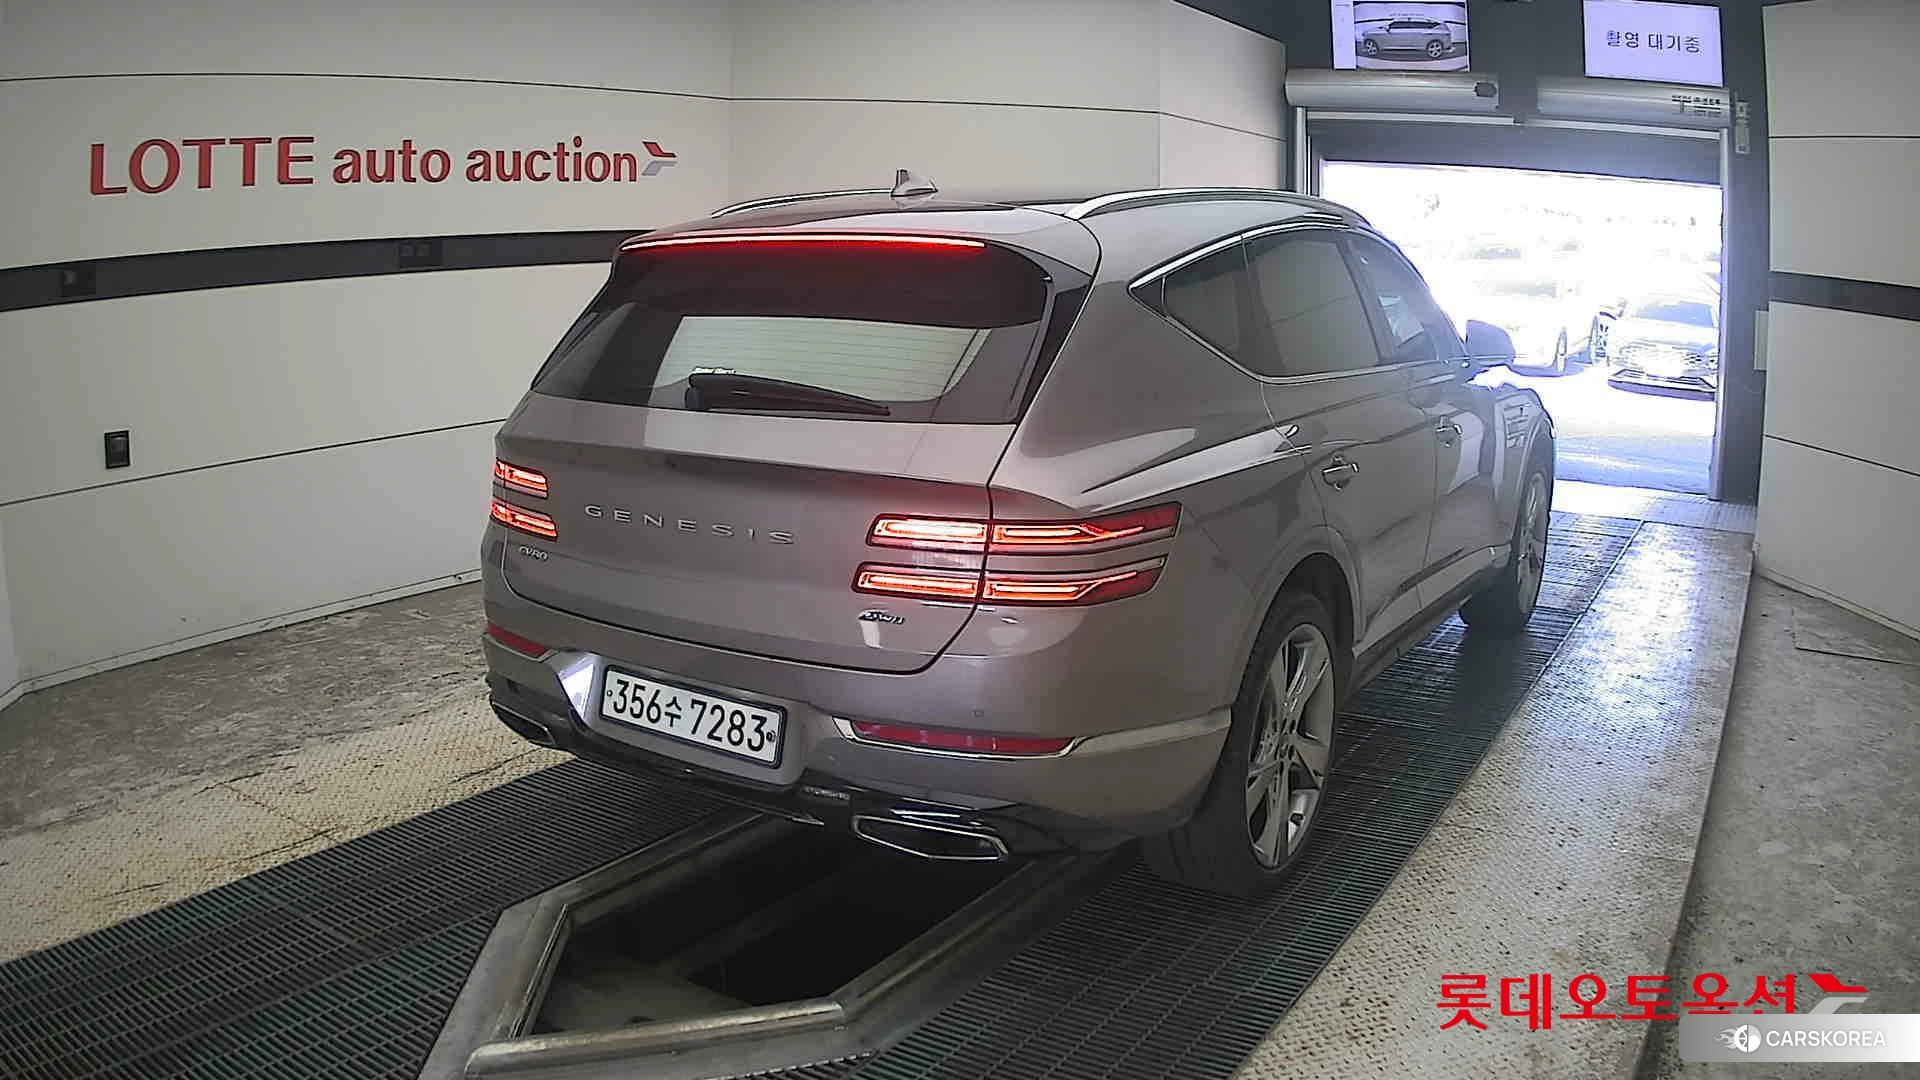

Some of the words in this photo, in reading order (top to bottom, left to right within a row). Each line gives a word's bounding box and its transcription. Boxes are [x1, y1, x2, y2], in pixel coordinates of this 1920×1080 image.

[1606, 30, 1640, 48] 촬영
[1648, 33, 1701, 53] 대기중
[90, 136, 314, 195] LOTTE
[332, 138, 451, 184] auto
[465, 135, 638, 183] auction
[584, 504, 794, 544] GENESIS
